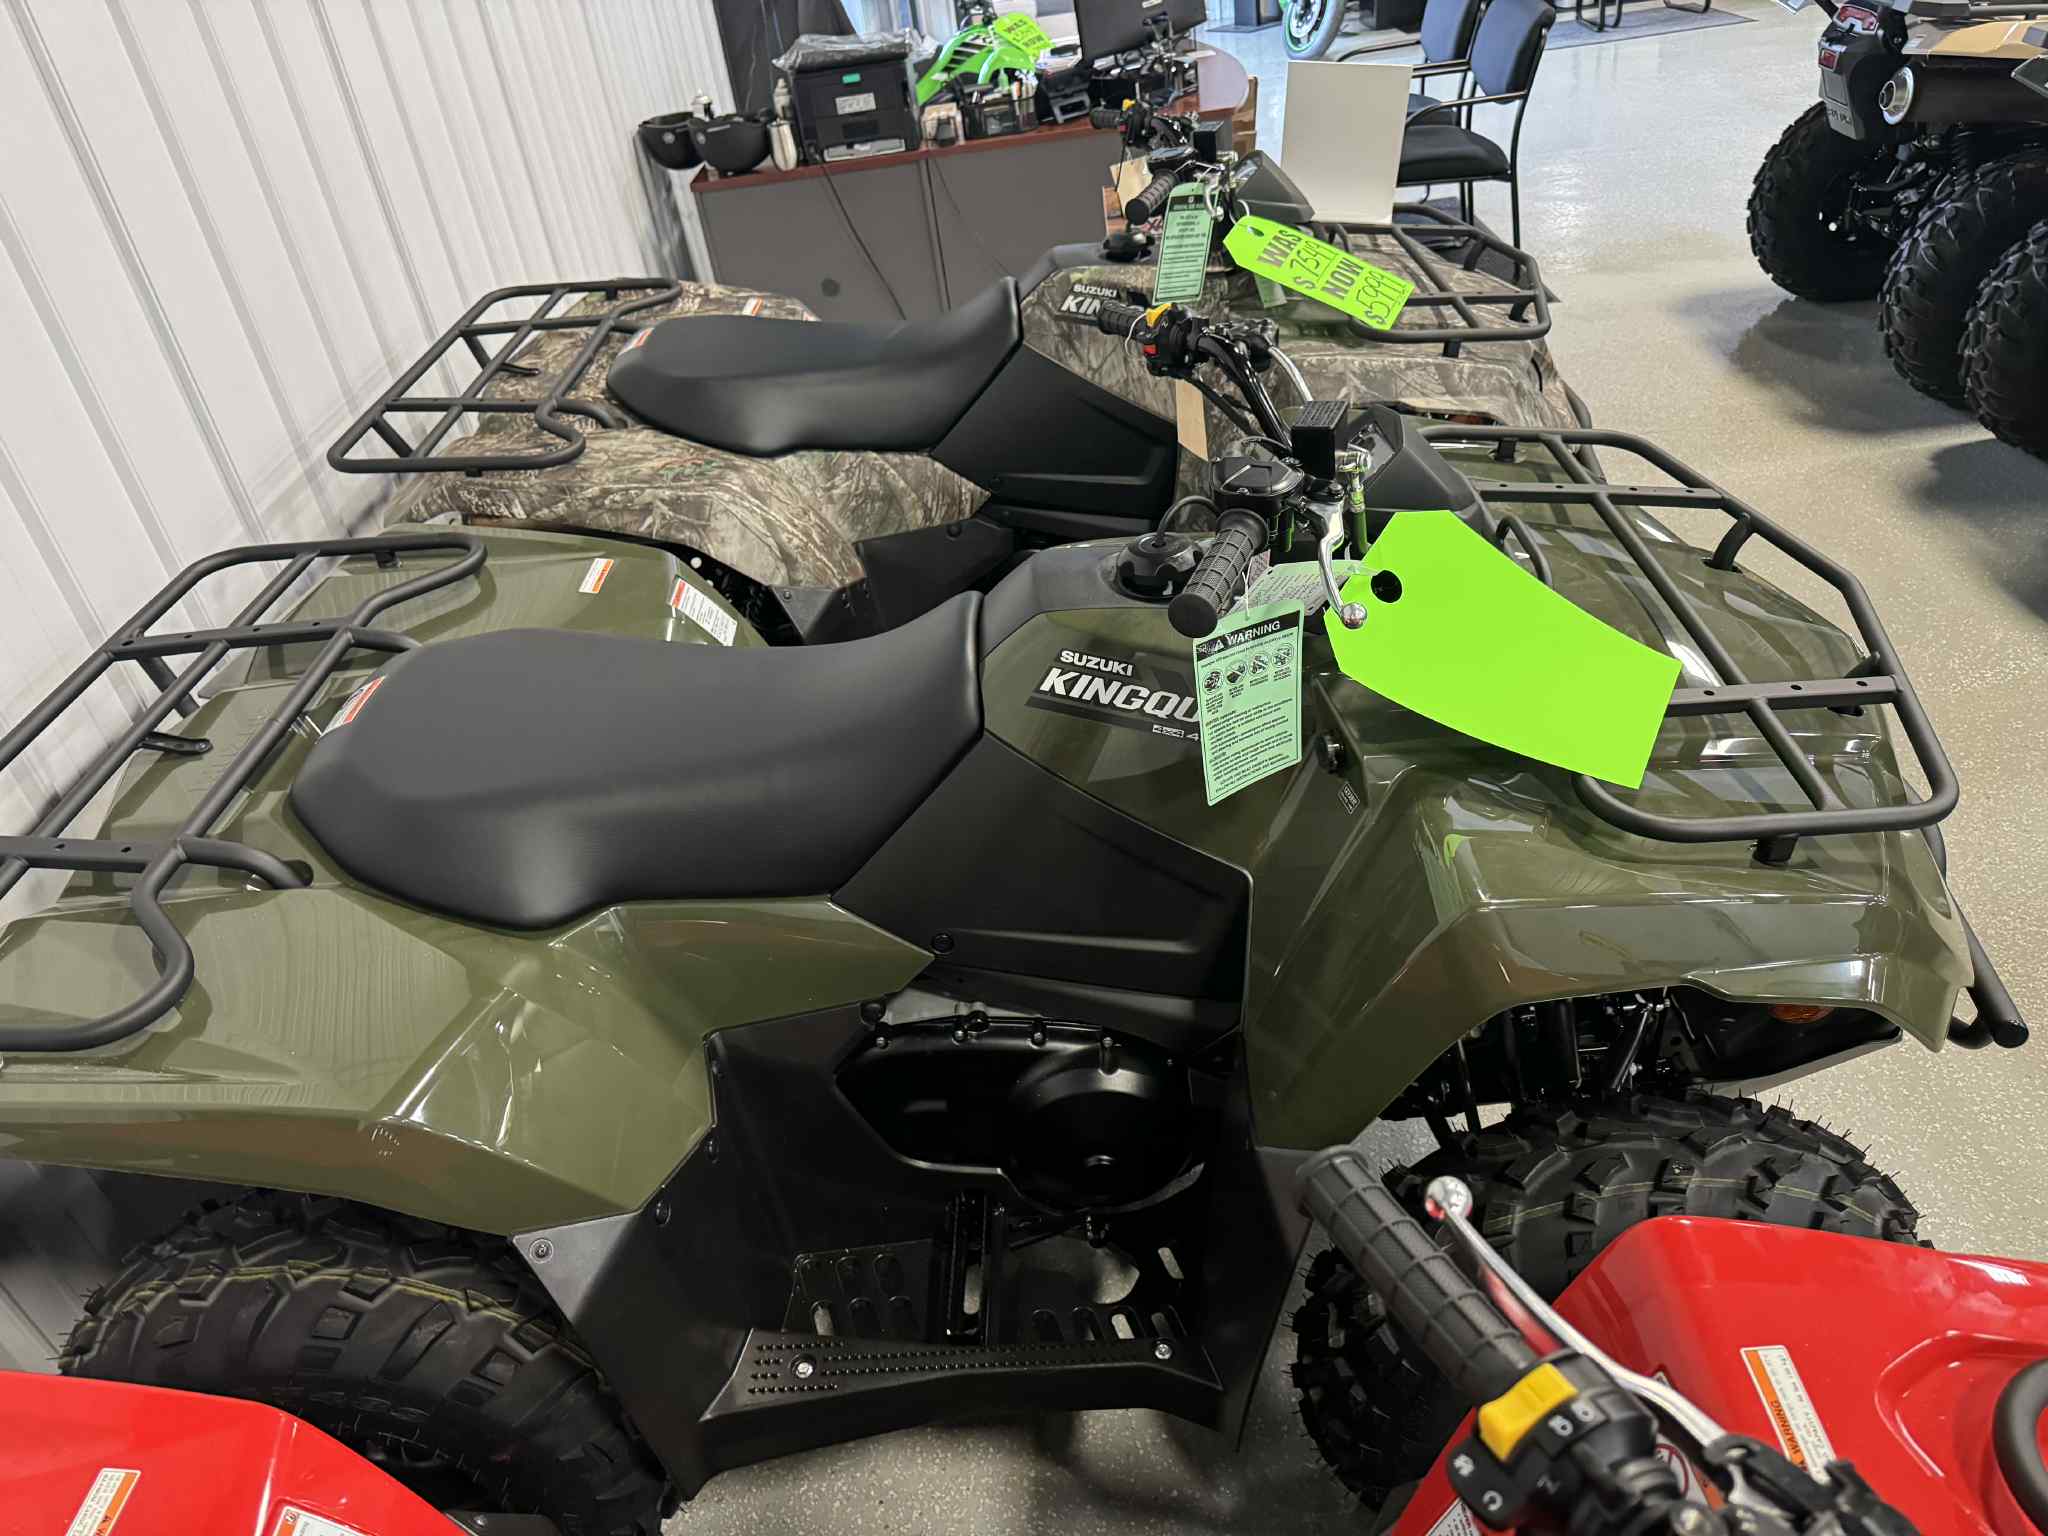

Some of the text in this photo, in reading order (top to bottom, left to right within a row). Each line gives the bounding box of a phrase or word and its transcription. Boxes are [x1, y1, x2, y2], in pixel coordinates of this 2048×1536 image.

[1257, 229, 1301, 268] WAS
[1073, 283, 1118, 298] SUZUKI
[1321, 257, 1364, 300] NOW
[1060, 294, 1101, 315] KIN
[1225, 620, 1281, 646] WARNING
[1059, 650, 1133, 677] SUZUKI
[1039, 667, 1201, 723] KINGQU
[1771, 1399, 1801, 1455] WARNING
